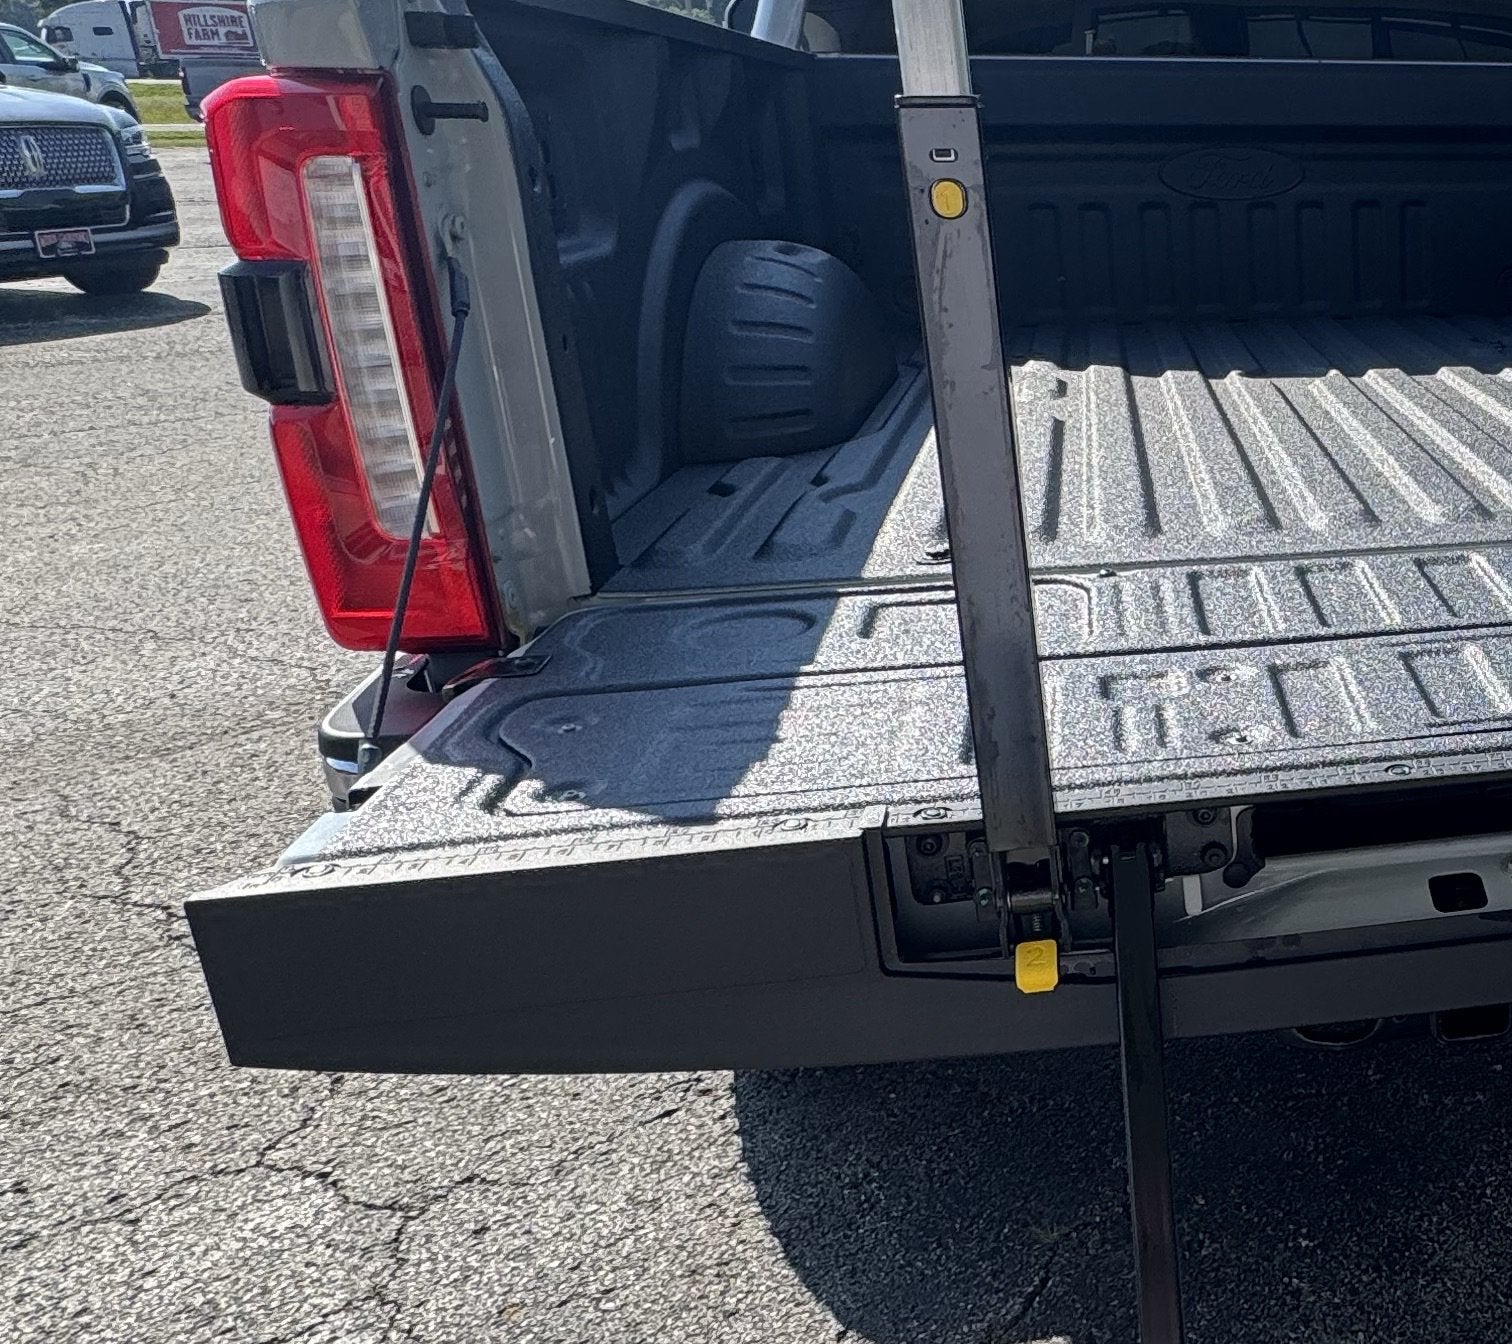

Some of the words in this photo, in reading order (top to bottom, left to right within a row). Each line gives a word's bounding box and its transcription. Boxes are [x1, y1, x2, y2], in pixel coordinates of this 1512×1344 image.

[183, 14, 246, 28] HILLSHIRE
[187, 27, 221, 41] FARM
[1026, 946, 1047, 967] 2
